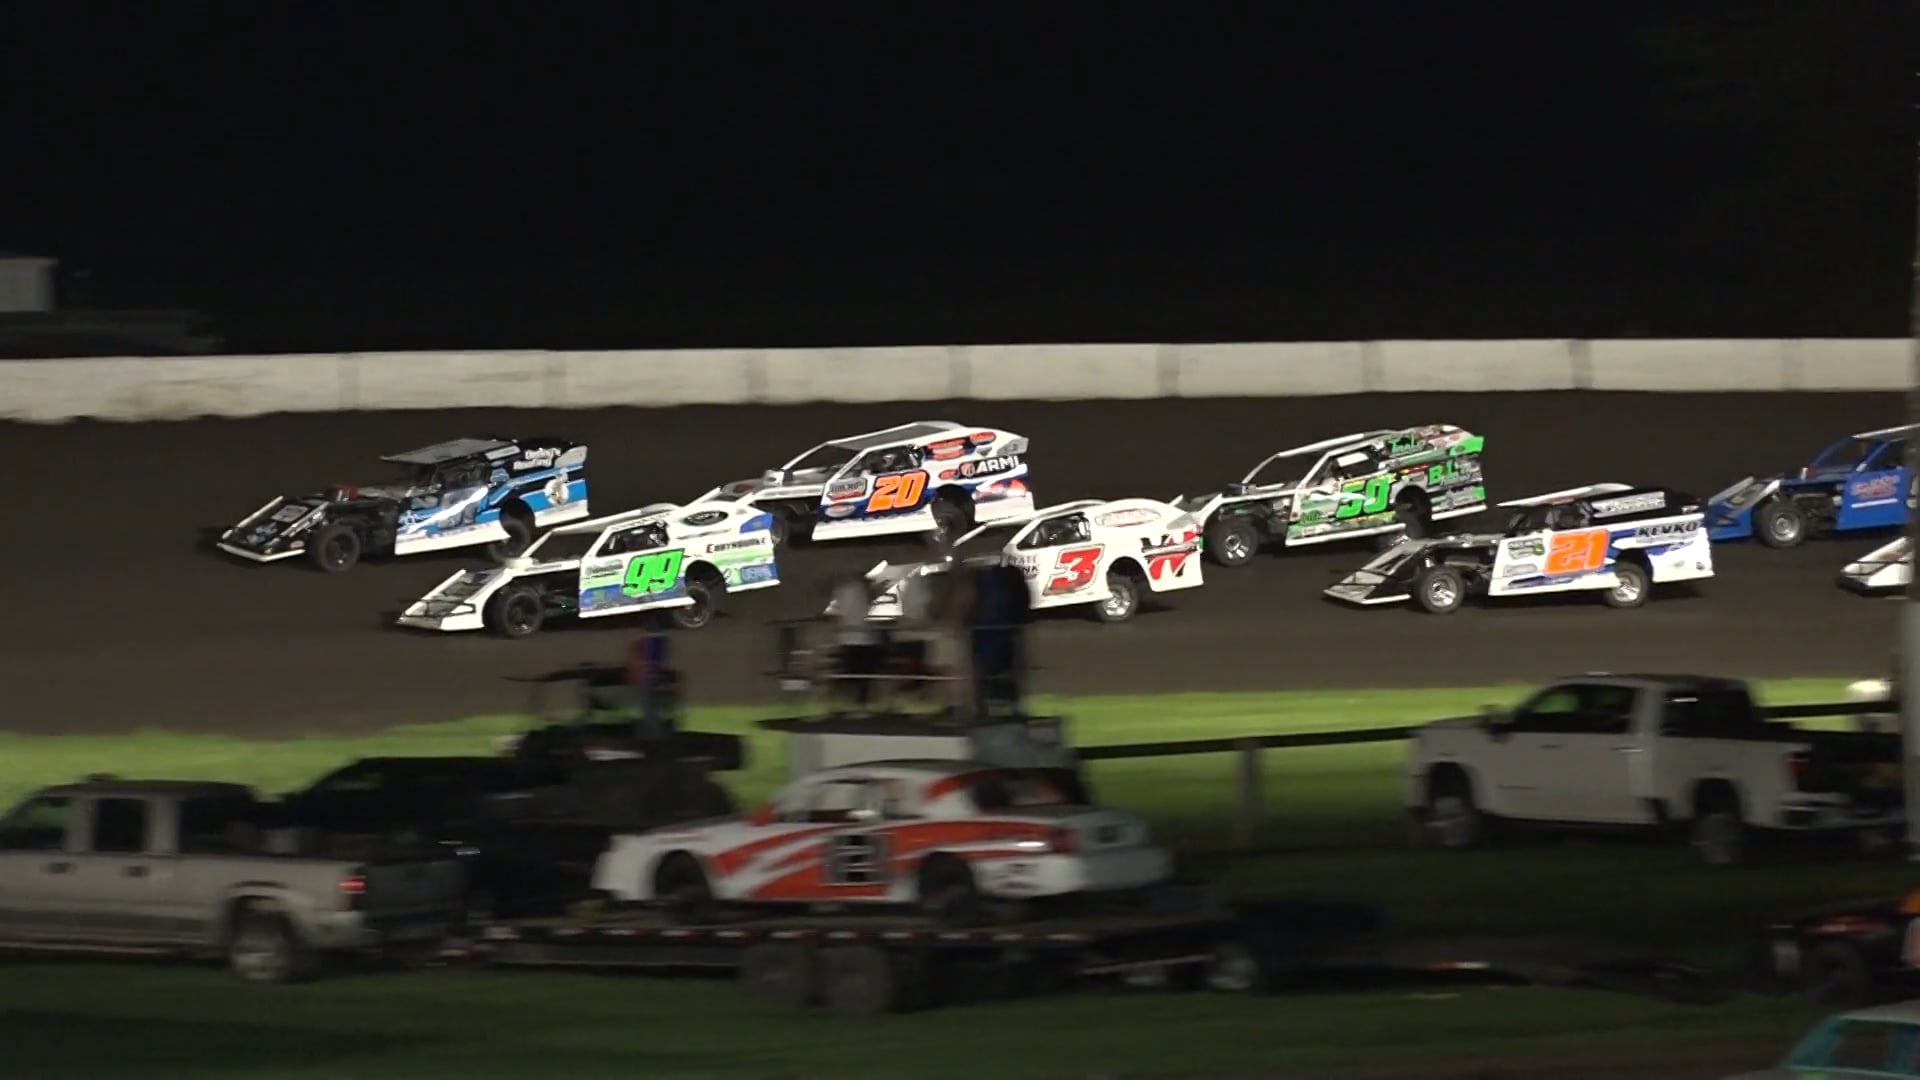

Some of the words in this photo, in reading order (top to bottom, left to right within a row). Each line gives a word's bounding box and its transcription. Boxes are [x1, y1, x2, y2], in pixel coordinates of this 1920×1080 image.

[866, 470, 928, 513] 20
[623, 548, 685, 597] 99
[1046, 546, 1104, 592] 3
[1543, 528, 1609, 577] 21
